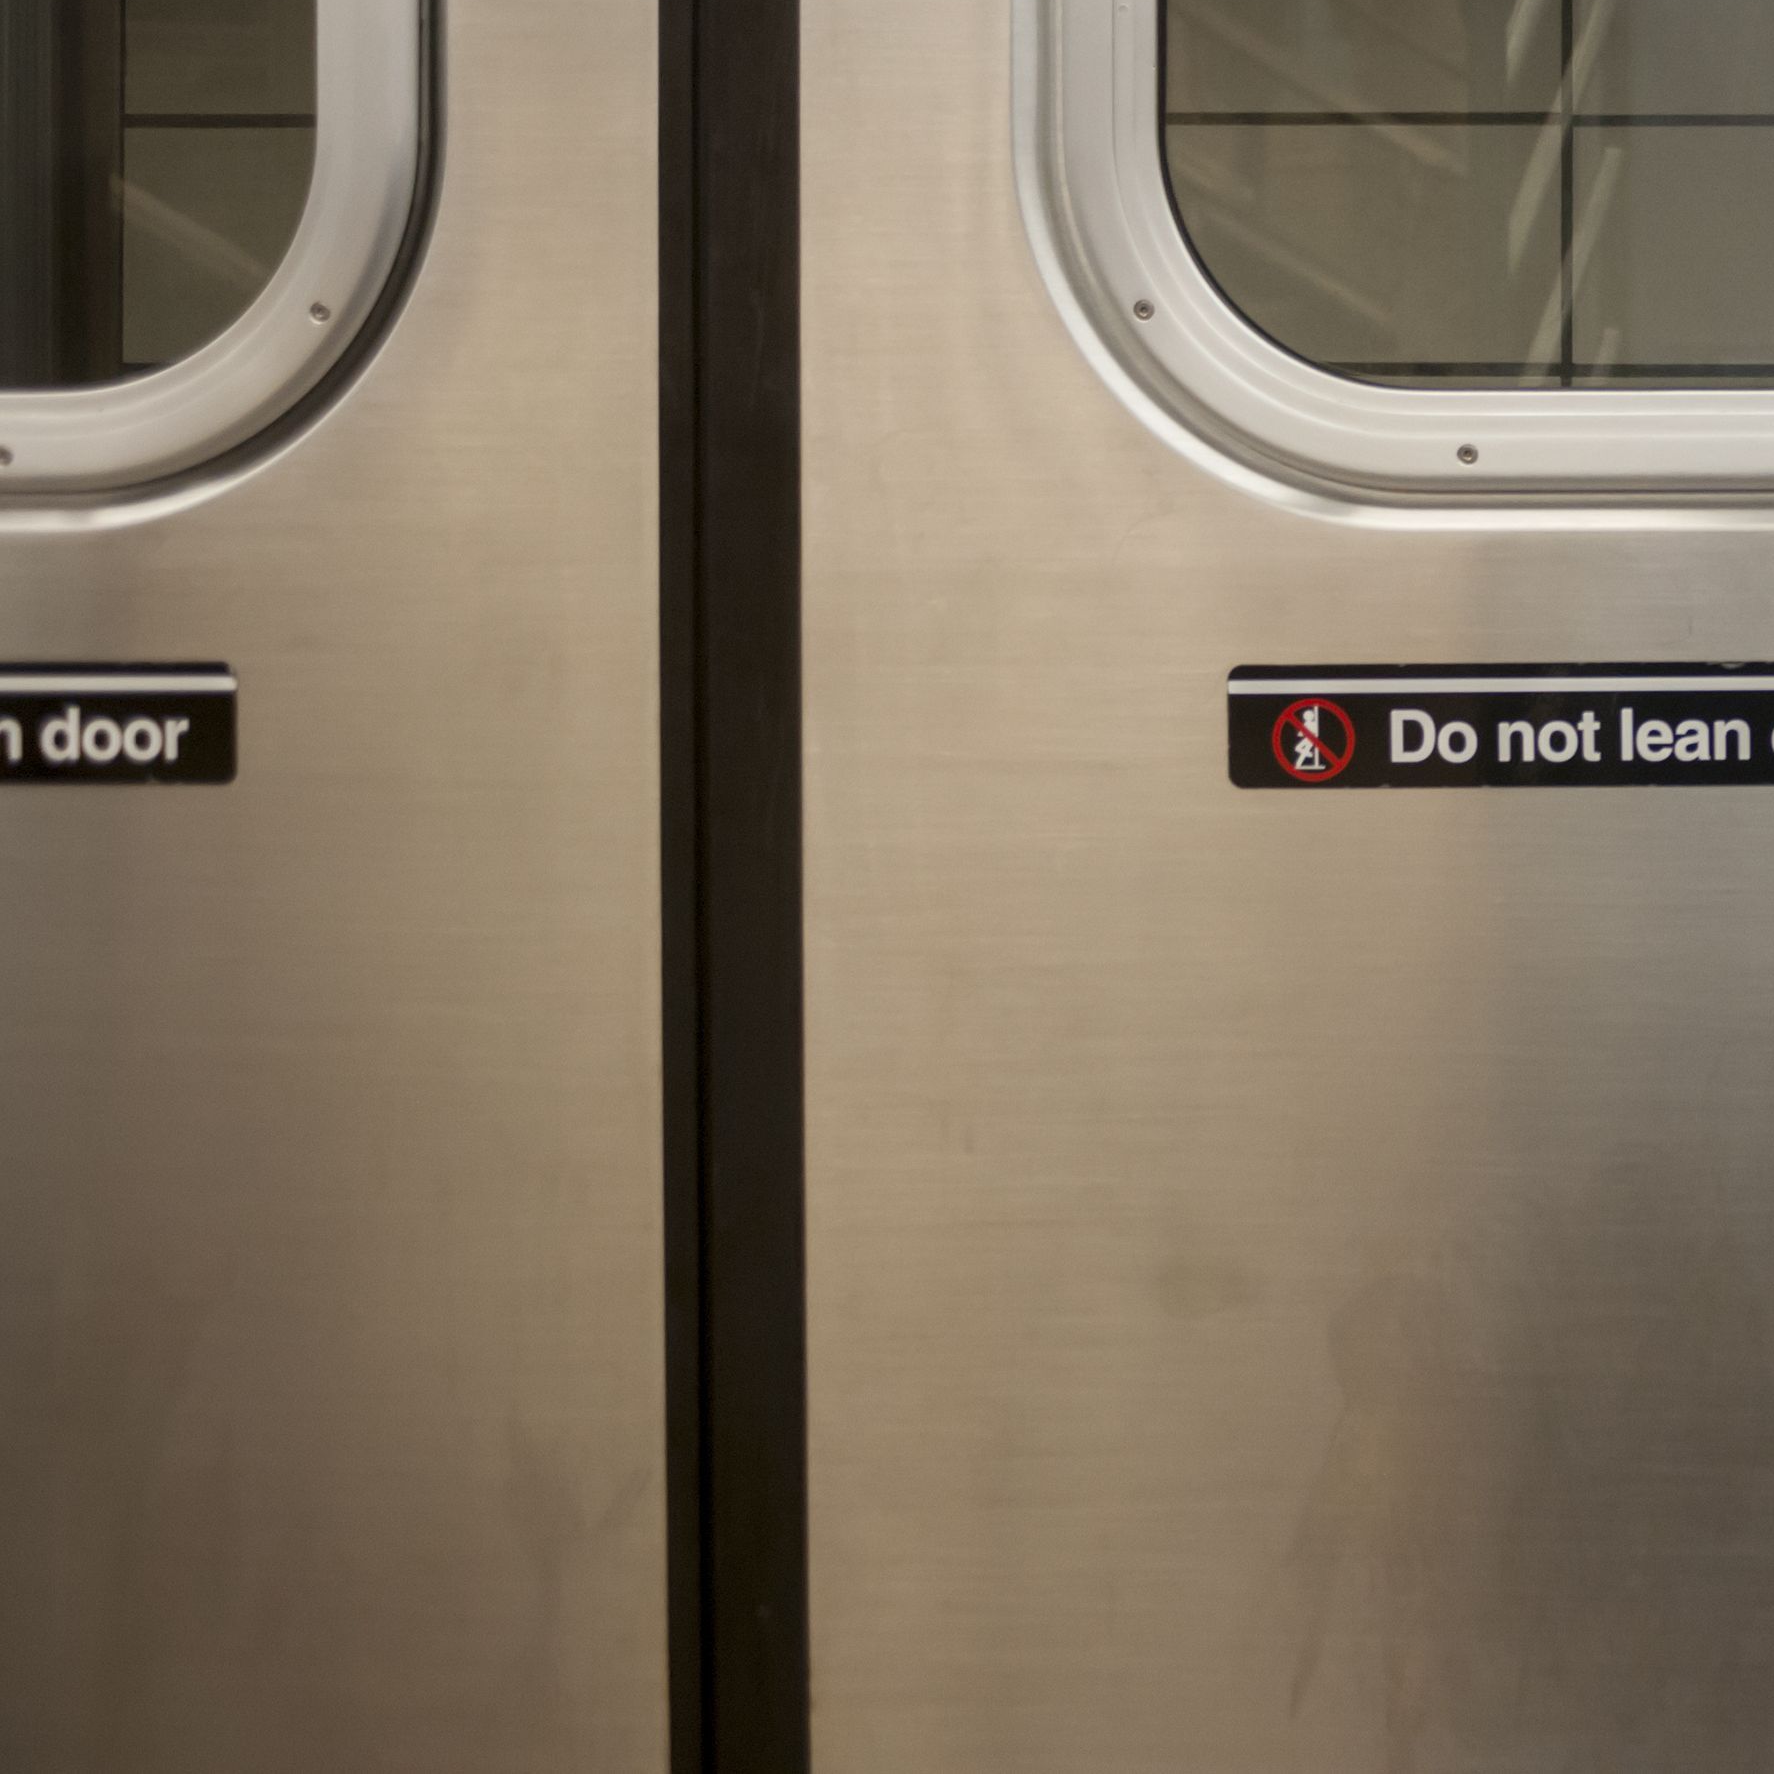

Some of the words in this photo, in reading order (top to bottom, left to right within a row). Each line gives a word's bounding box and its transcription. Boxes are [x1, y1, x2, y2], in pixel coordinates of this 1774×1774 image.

[40, 705, 191, 762] door
[1389, 708, 1479, 764] Do
[1497, 710, 1602, 763] not
[1620, 707, 1752, 763] lean
